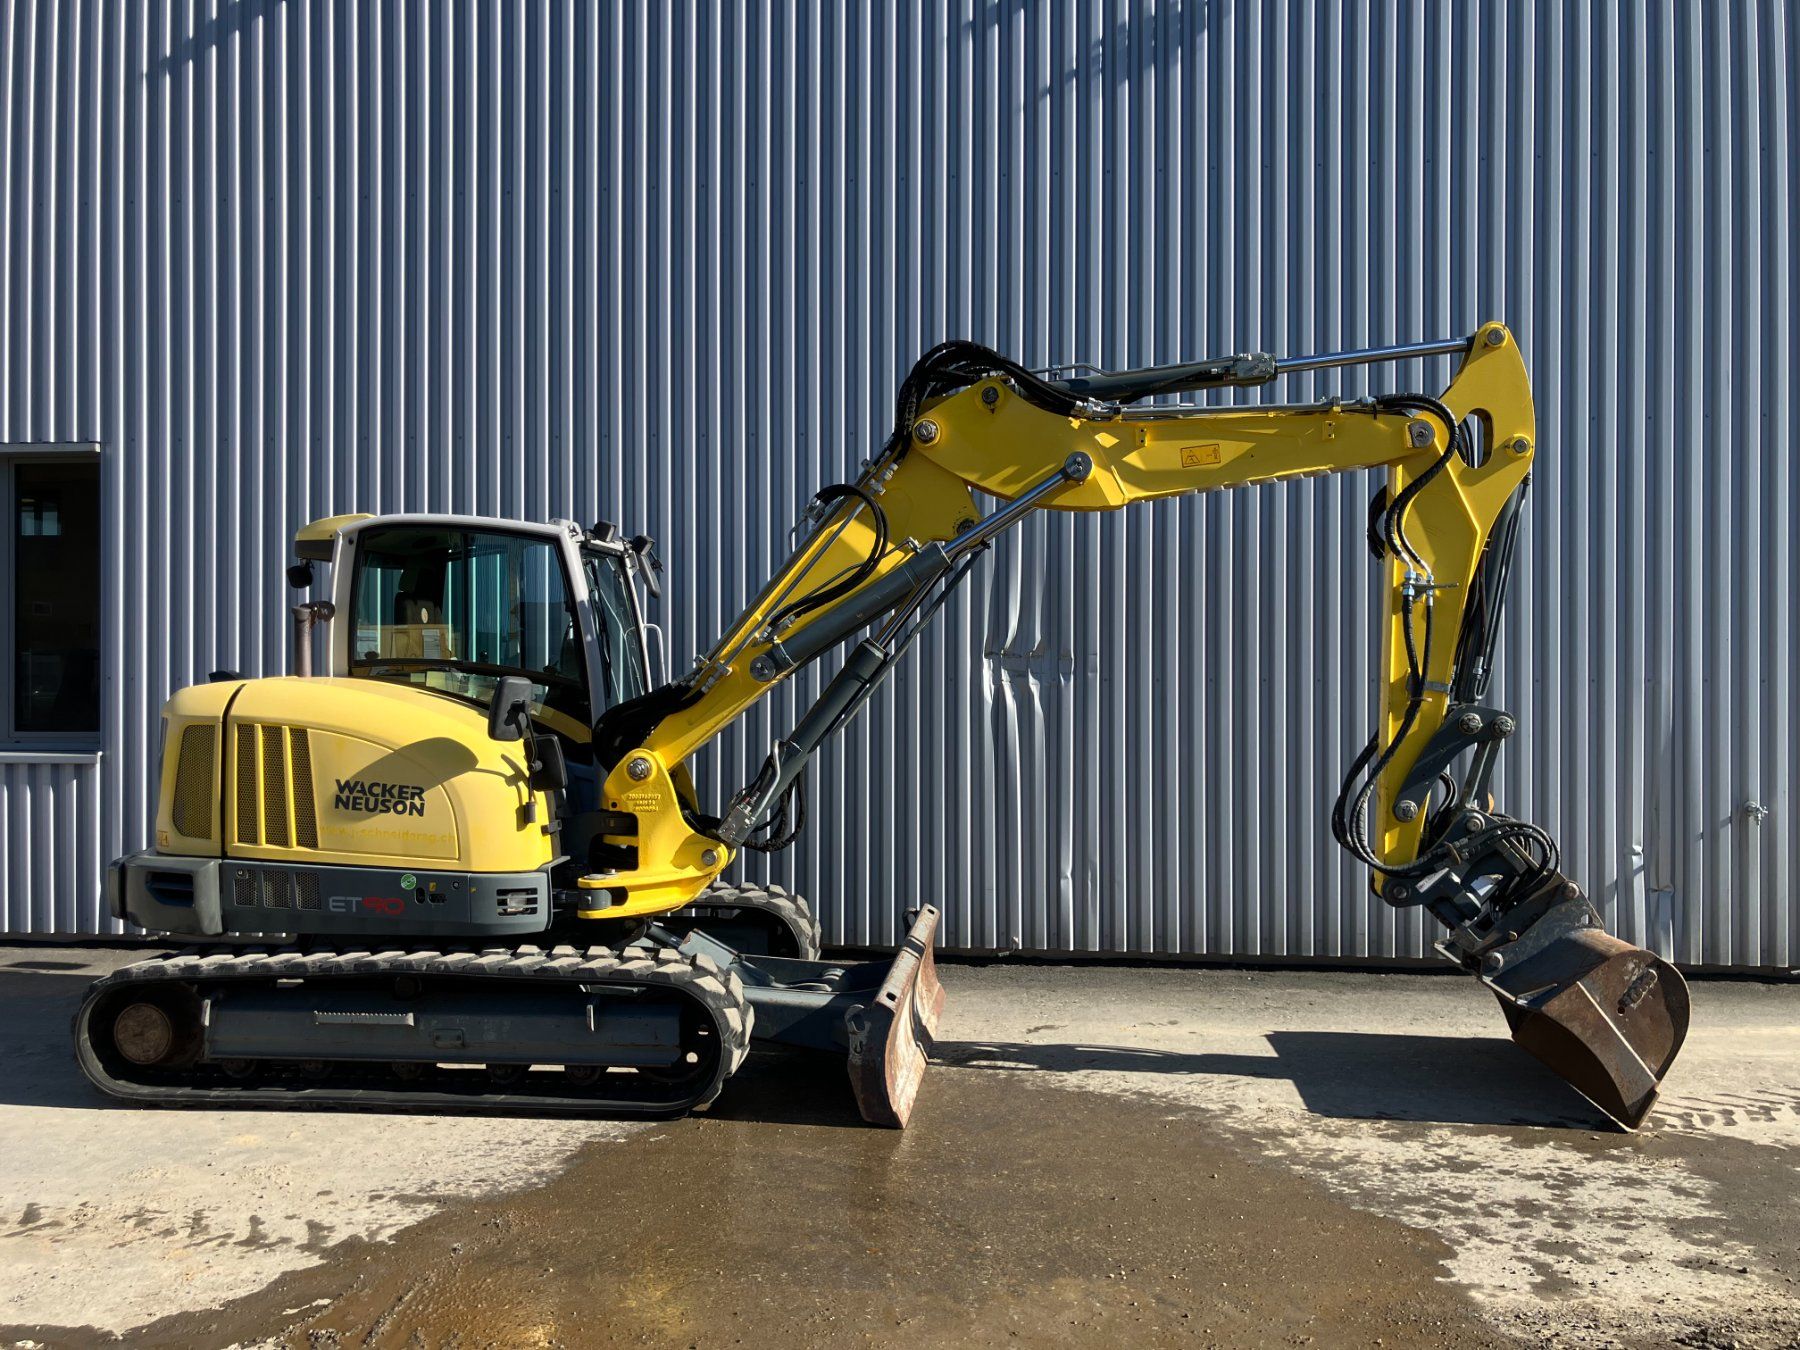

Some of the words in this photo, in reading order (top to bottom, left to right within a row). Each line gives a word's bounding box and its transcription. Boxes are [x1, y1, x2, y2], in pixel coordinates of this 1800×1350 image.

[335, 779, 425, 801] WACKER
[335, 795, 425, 817] NEUSON
[329, 896, 405, 915] ET90
